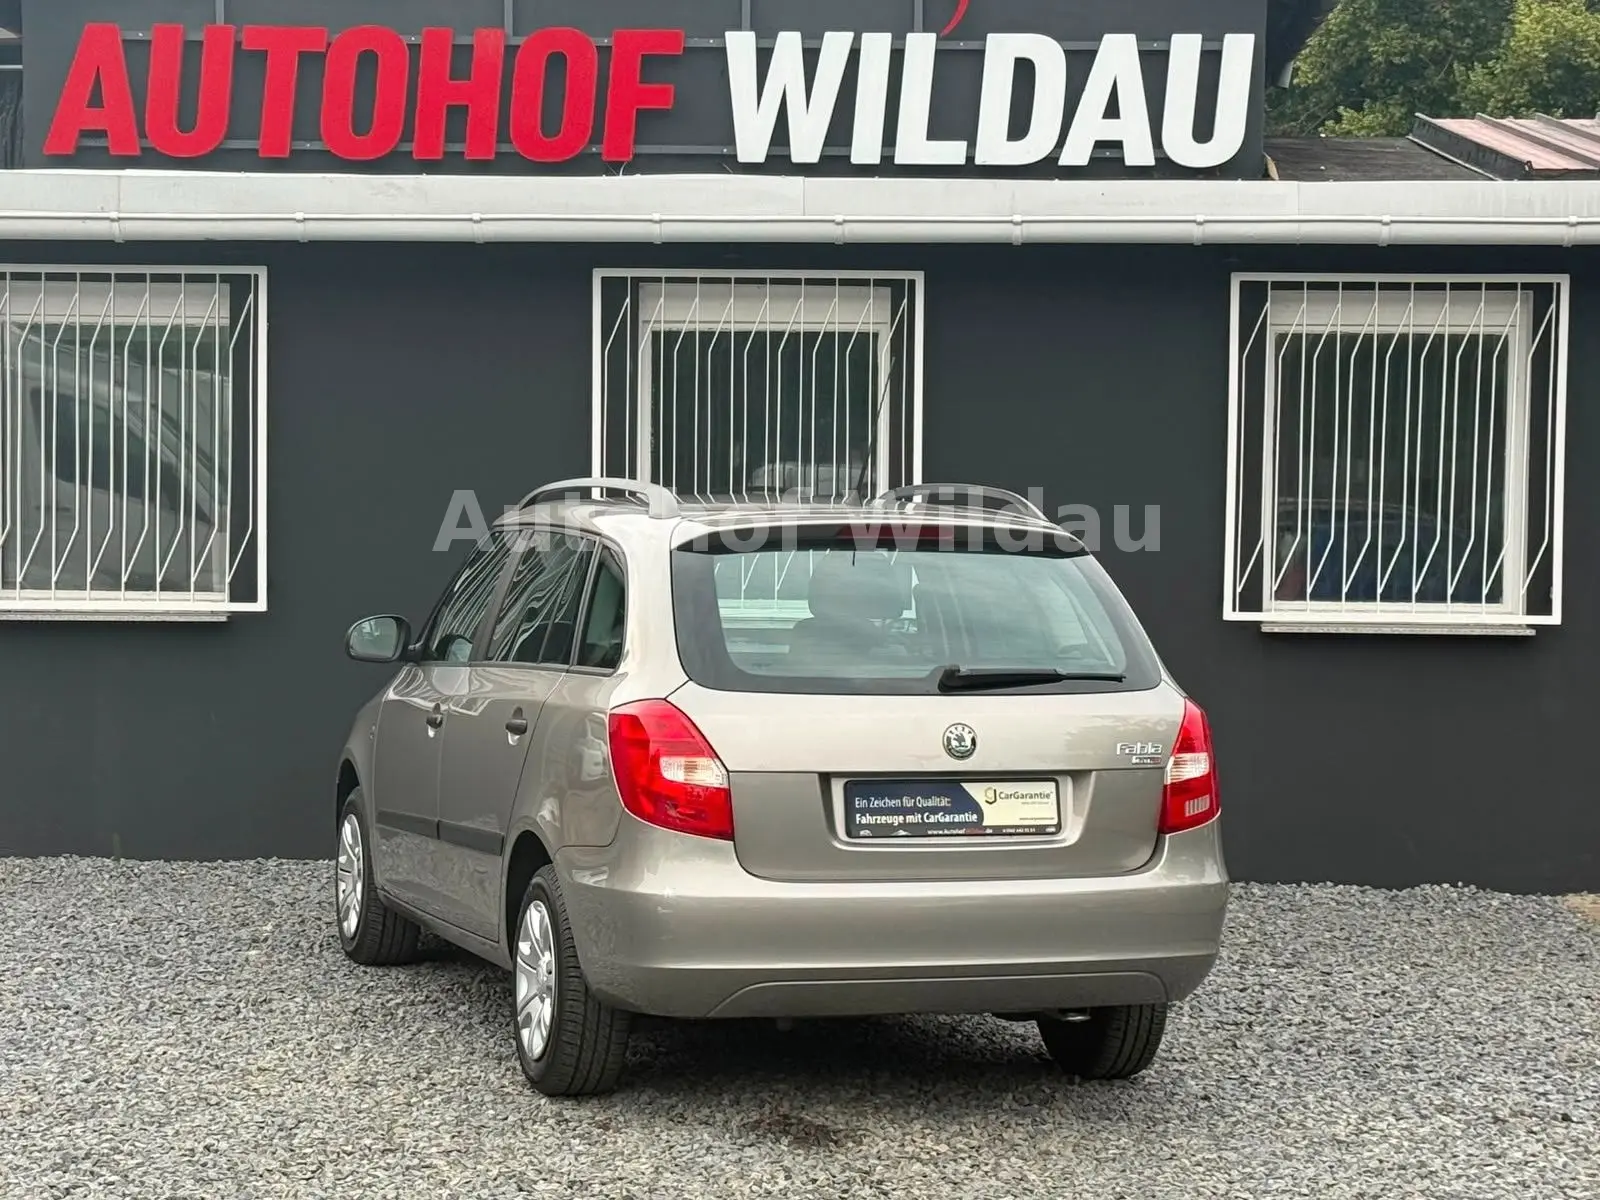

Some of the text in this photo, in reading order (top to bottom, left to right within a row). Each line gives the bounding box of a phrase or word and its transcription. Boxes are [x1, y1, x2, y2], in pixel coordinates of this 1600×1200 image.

[43, 23, 1255, 168] AUTOHOF WILDAU
[1116, 742, 1163, 755] Fabia
[855, 795, 951, 808] Ein Zeichen für Qualität:
[998, 791, 1051, 800] CarGarantie
[855, 811, 978, 826] Fahrzeuge mit CarGarantie
